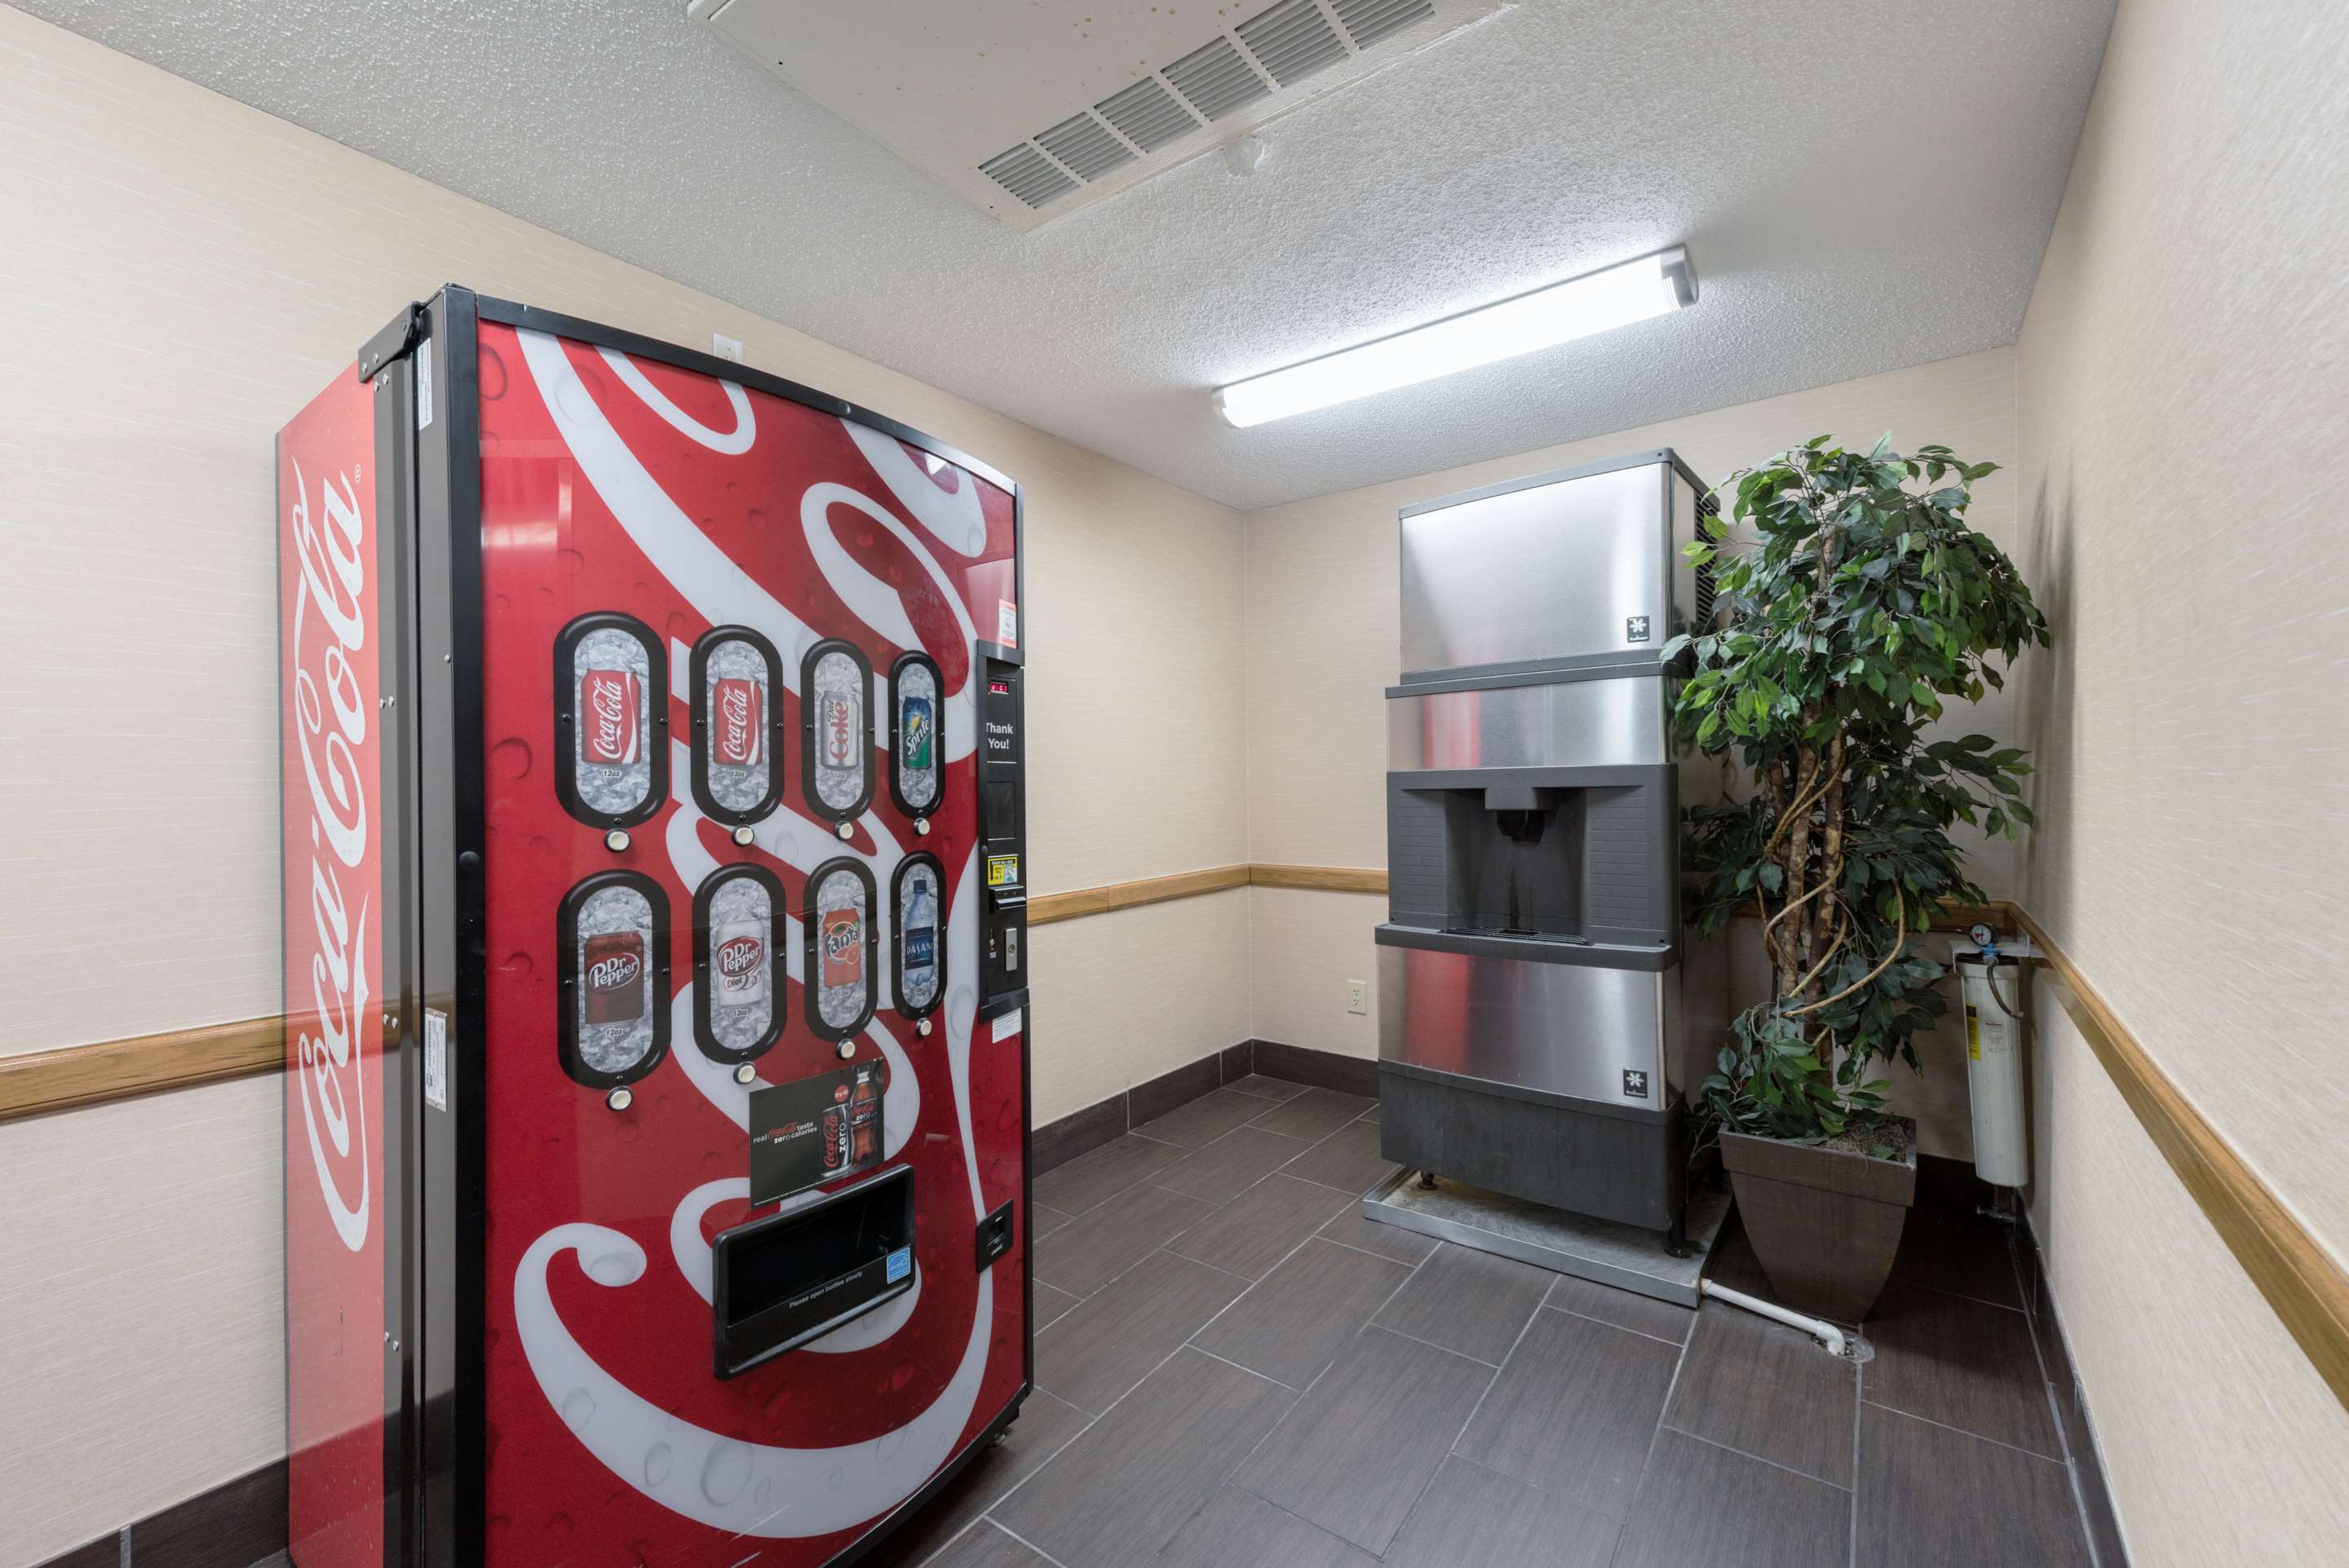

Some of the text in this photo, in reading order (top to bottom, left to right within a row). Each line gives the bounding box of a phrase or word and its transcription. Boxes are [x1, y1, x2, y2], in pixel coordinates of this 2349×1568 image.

[829, 700, 849, 761] Coke
[905, 717, 931, 756] Sprite
[986, 722, 1013, 735] Thank
[988, 738, 1010, 749] You!
[604, 770, 620, 778] 12oz
[735, 943, 752, 956] Dr
[825, 926, 860, 959] Fanta
[608, 957, 626, 973] Dr
[723, 945, 760, 973] Pepper
[593, 960, 638, 988] Pepper
[606, 1027, 623, 1037] 12oz
[856, 1111, 871, 1121] zero
[753, 1133, 768, 1144] real
[797, 1121, 814, 1131] taste
[774, 1126, 817, 1144] zero calories
[790, 1296, 809, 1309] Please
[810, 1288, 825, 1299] open
[825, 1279, 845, 1292] bottles
